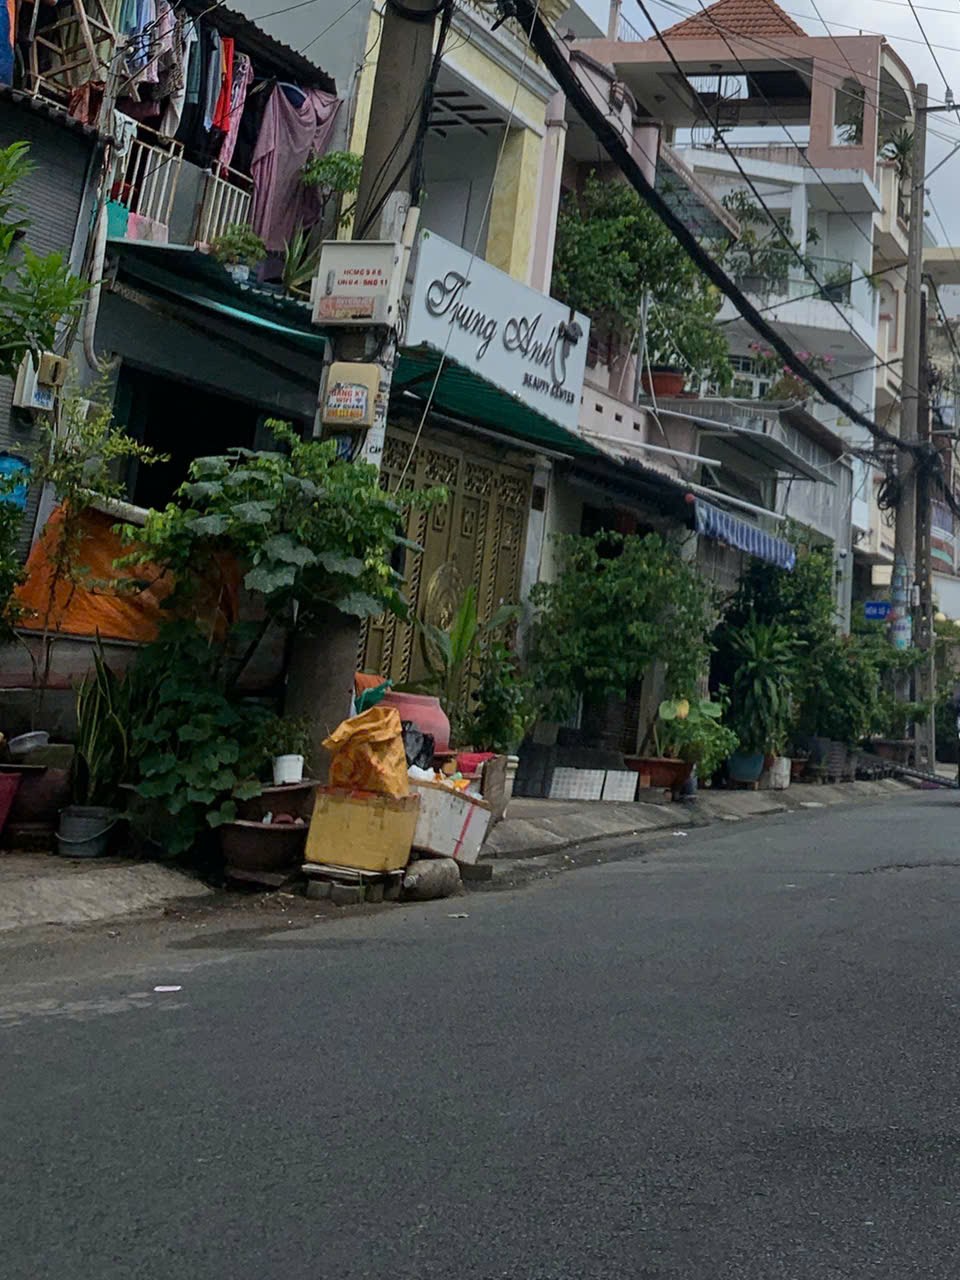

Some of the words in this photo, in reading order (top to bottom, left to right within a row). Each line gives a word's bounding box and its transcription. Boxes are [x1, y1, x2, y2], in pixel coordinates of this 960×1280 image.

[425, 271, 498, 361] Trung
[503, 312, 560, 372] Anh
[522, 372, 550, 395] BEAUTY
[550, 384, 575, 404] CENTER
